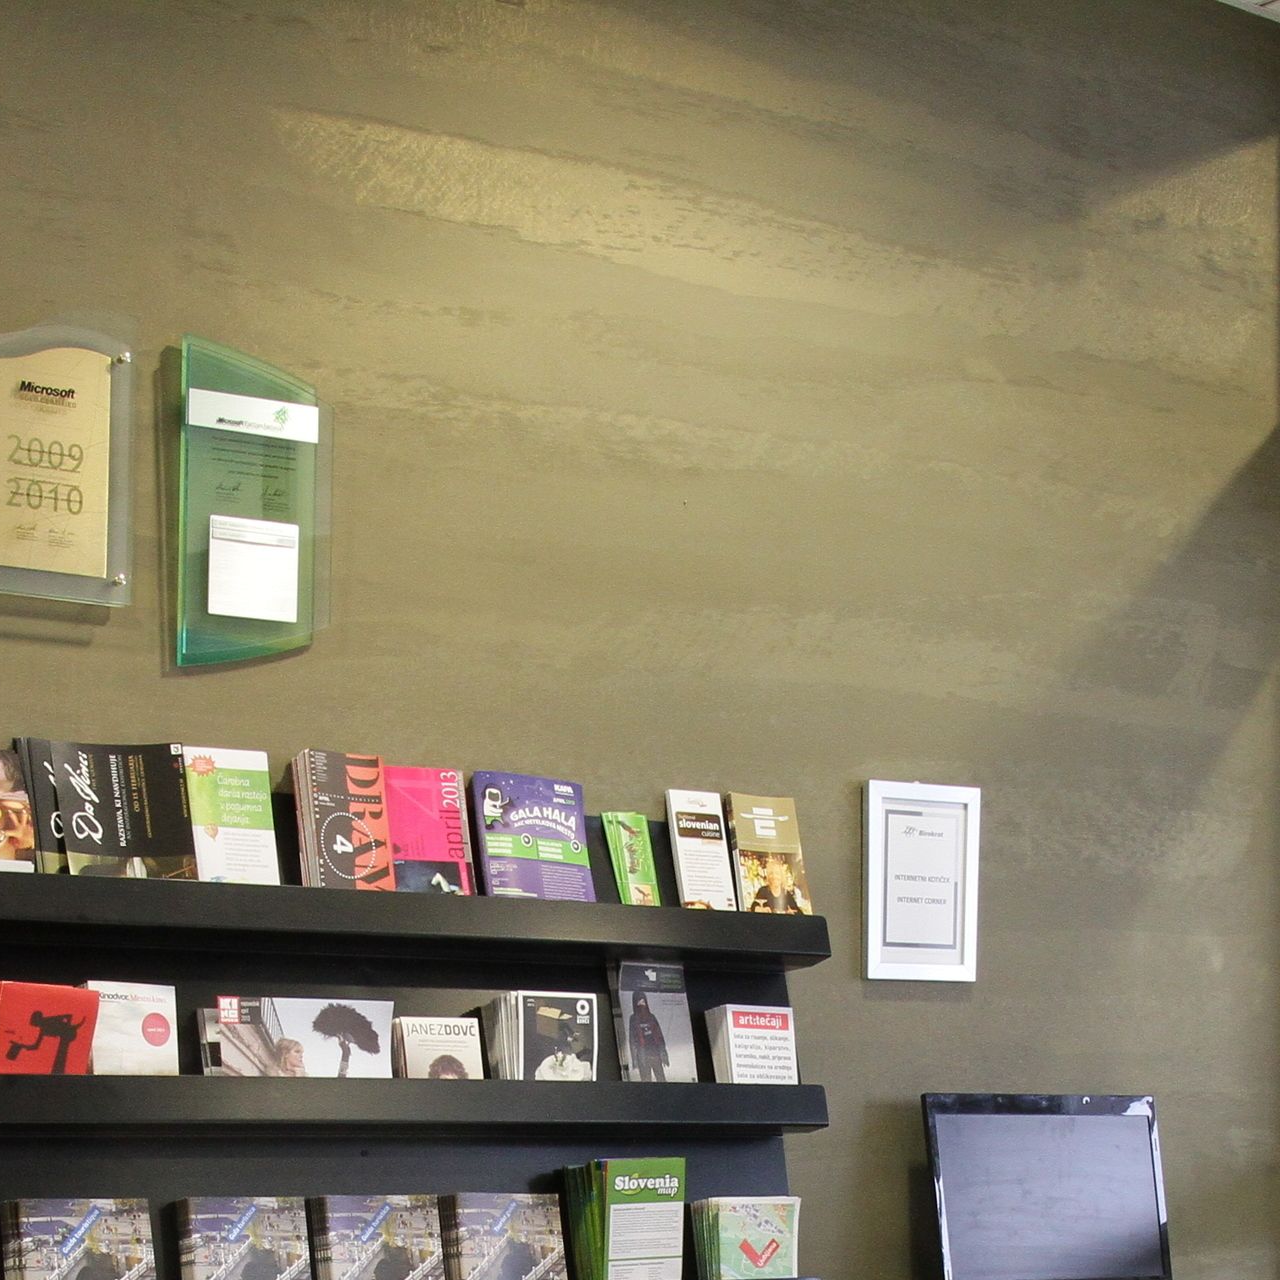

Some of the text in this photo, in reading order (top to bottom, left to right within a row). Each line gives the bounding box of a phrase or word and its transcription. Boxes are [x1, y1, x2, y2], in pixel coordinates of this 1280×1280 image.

[19, 380, 76, 399] Microsoft
[7, 434, 84, 473] 2009
[6, 476, 83, 515] 2010
[72, 801, 103, 845] Da
[439, 771, 466, 860] april 2013
[510, 806, 576, 832] GALA HALA
[679, 818, 719, 831] slovenian
[333, 834, 354, 855] 4
[895, 874, 927, 882] INTERNETNI
[897, 896, 923, 904] INTERNET
[738, 1014, 782, 1029] art:tečaji
[614, 1174, 679, 1190] Slovenia
[657, 1187, 677, 1197] map
